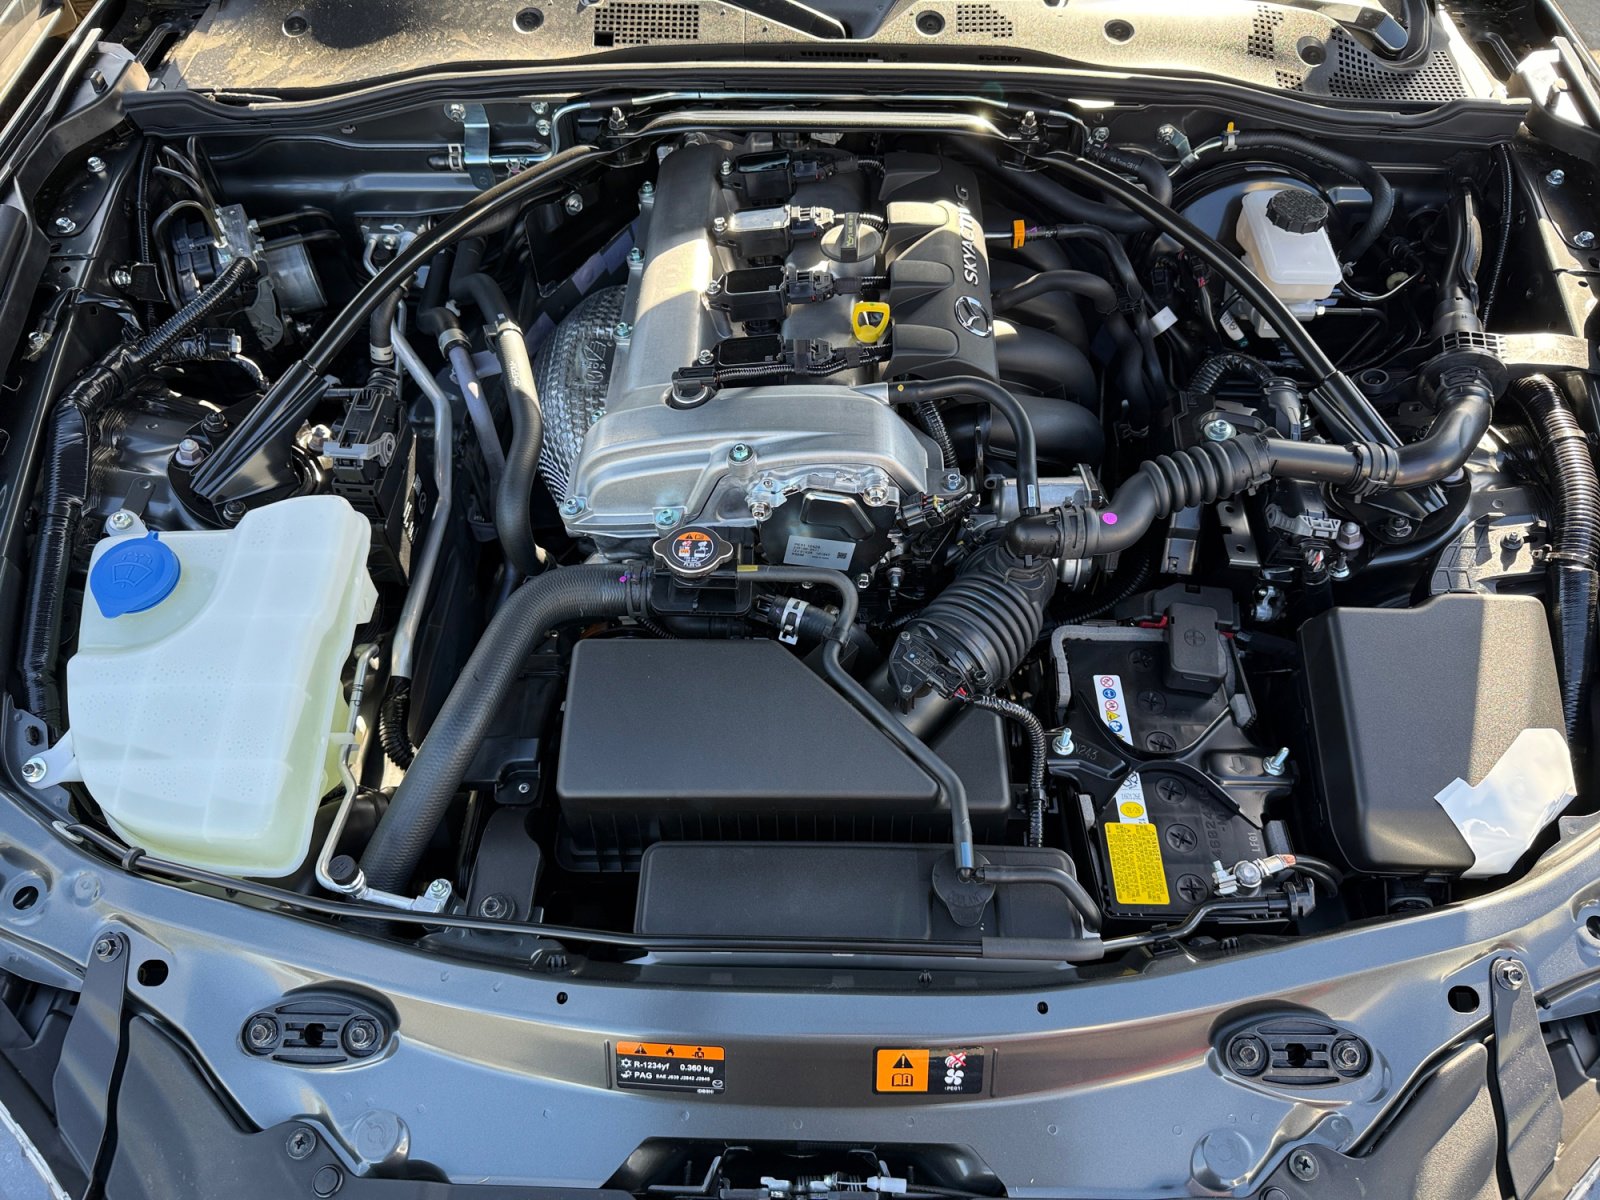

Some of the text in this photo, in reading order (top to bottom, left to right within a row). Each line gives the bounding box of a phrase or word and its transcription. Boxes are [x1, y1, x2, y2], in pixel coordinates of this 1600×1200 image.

[954, 184, 979, 287] SKYACTIV-G
[633, 1060, 670, 1072] R-1234yf
[703, 1063, 714, 1074] kg
[634, 1071, 653, 1079] PAG
